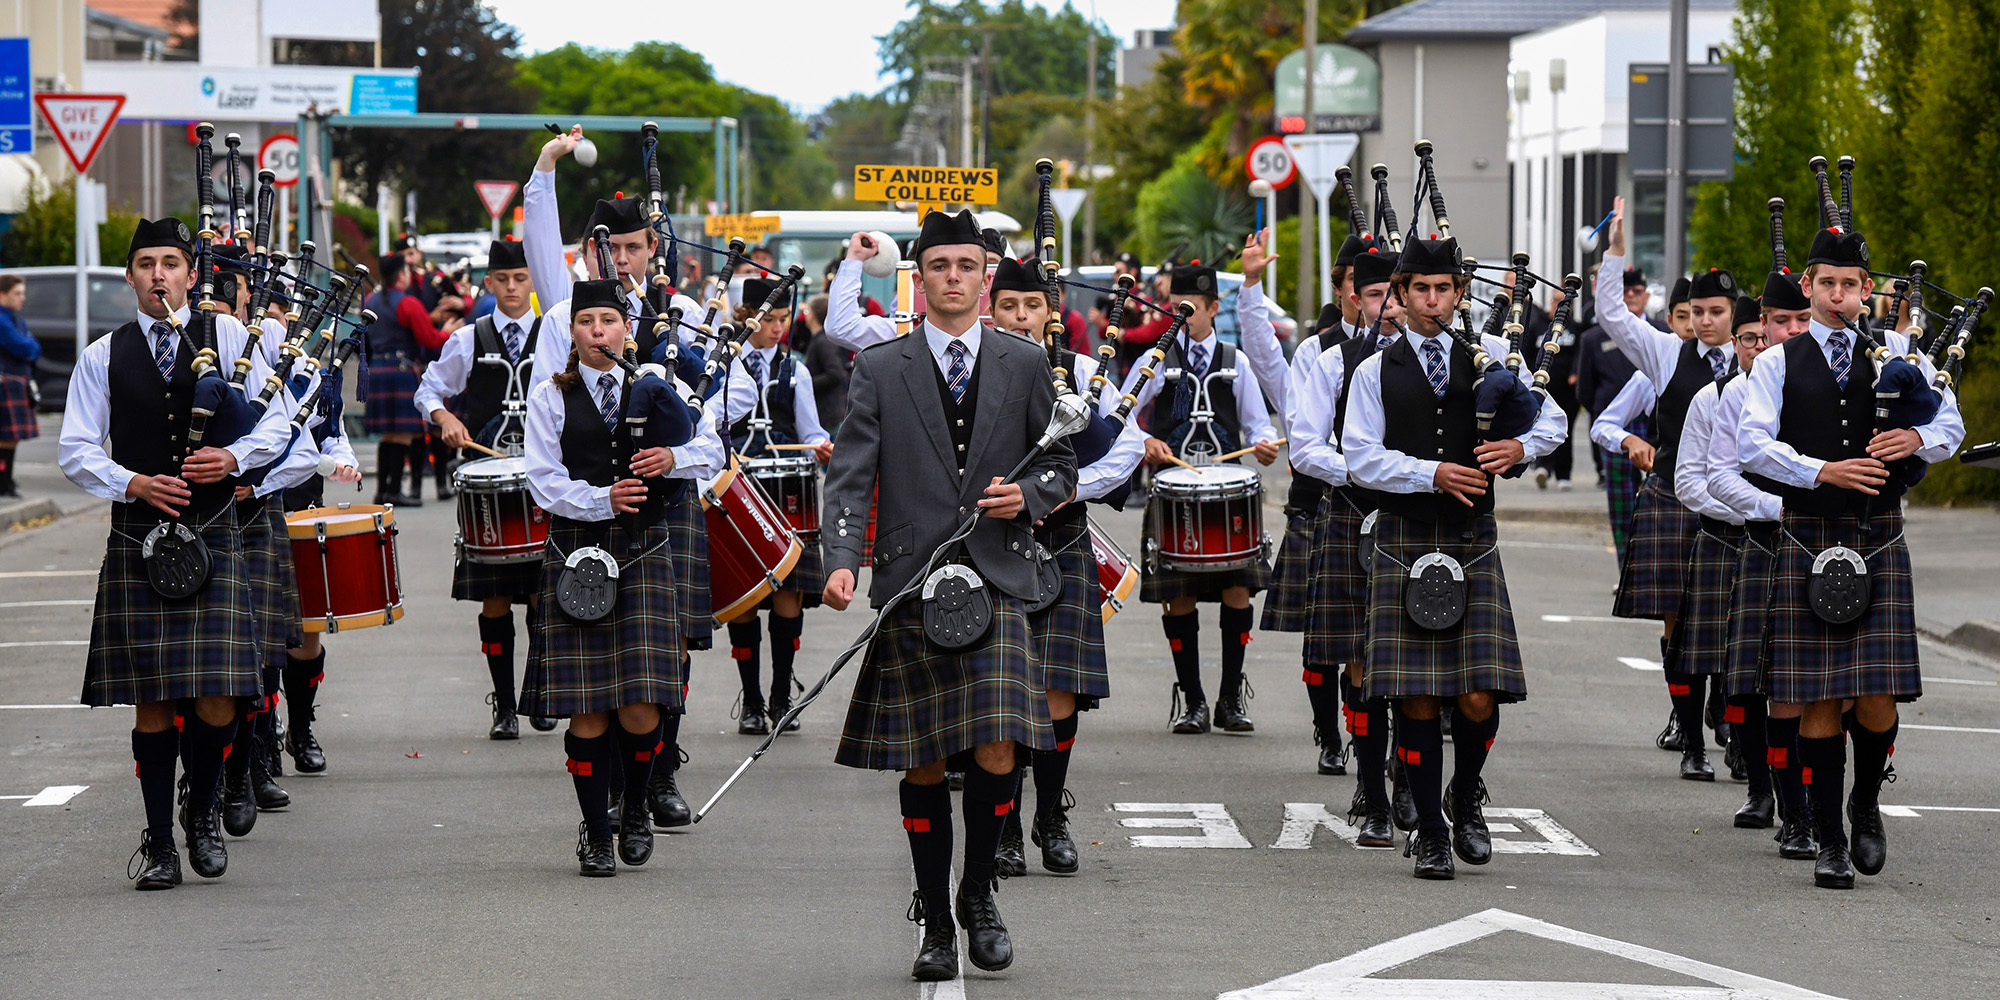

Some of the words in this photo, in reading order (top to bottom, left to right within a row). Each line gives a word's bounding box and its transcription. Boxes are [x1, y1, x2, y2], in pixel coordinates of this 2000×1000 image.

[218, 91, 257, 109] Laser
[62, 107, 98, 125] GIVE
[1281, 117, 1306, 133] NO
[70, 130, 91, 142] WAY
[270, 150, 298, 170] 50
[1257, 153, 1287, 174] 50
[858, 168, 887, 183] ST.
[890, 169, 994, 187] ANDREWS
[885, 186, 975, 202] COLLEGE
[480, 494, 493, 545] Premier
[741, 496, 776, 542] Premier
[1182, 502, 1194, 553] Premier
